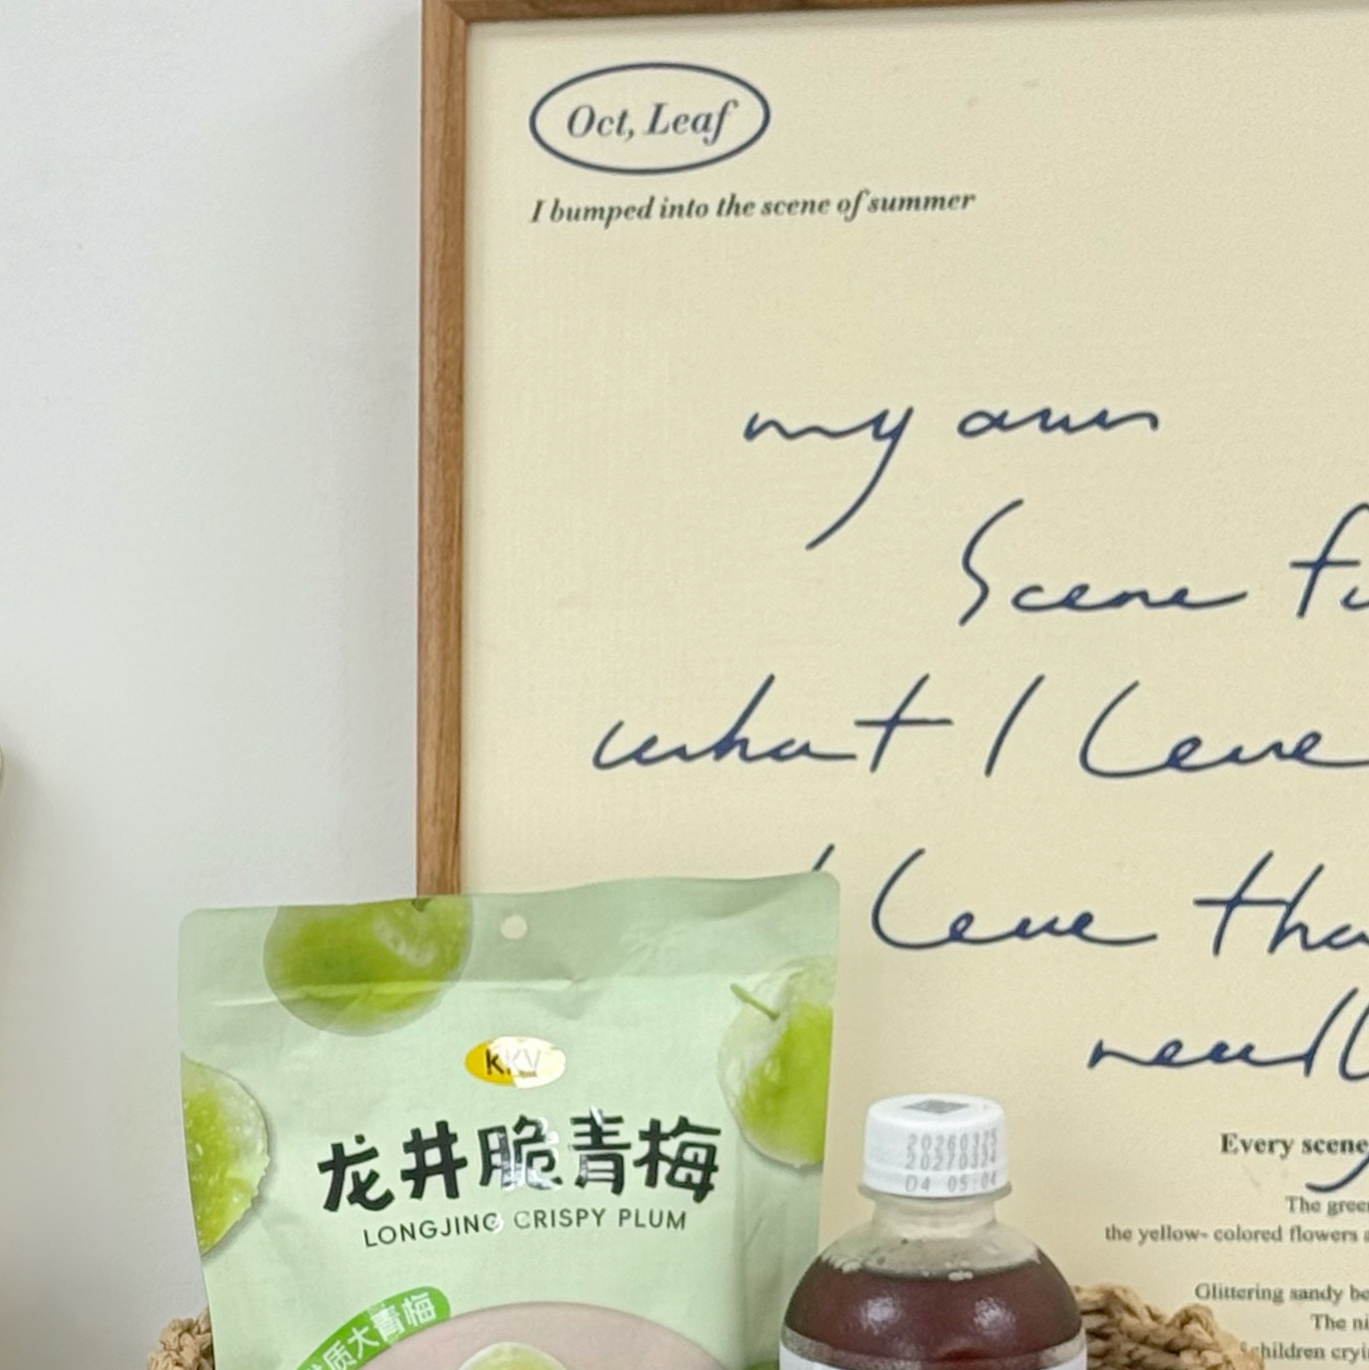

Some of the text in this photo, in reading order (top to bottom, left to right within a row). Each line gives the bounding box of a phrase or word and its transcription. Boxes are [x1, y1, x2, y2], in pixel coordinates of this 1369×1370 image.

[566, 98, 740, 147] Oct, Leaf
[530, 188, 977, 230] I bumped into the scene of summer
[742, 405, 915, 551] my
[591, 672, 954, 774] what
[316, 1105, 723, 1213] 龙井脆青梅
[1219, 1131, 1295, 1161] Every
[1284, 1194, 1321, 1214] The
[363, 1206, 687, 1249] LONGJING CRISPY PLUM
[1104, 1223, 1132, 1243] the
[1212, 1223, 1283, 1243] colored
[1289, 1224, 1359, 1244] flowers
[1194, 1282, 1285, 1306] Glittering
[1289, 1283, 1344, 1307] sandy
[1310, 1312, 1347, 1331] The
[1330, 1341, 1369, 1365] cryi
